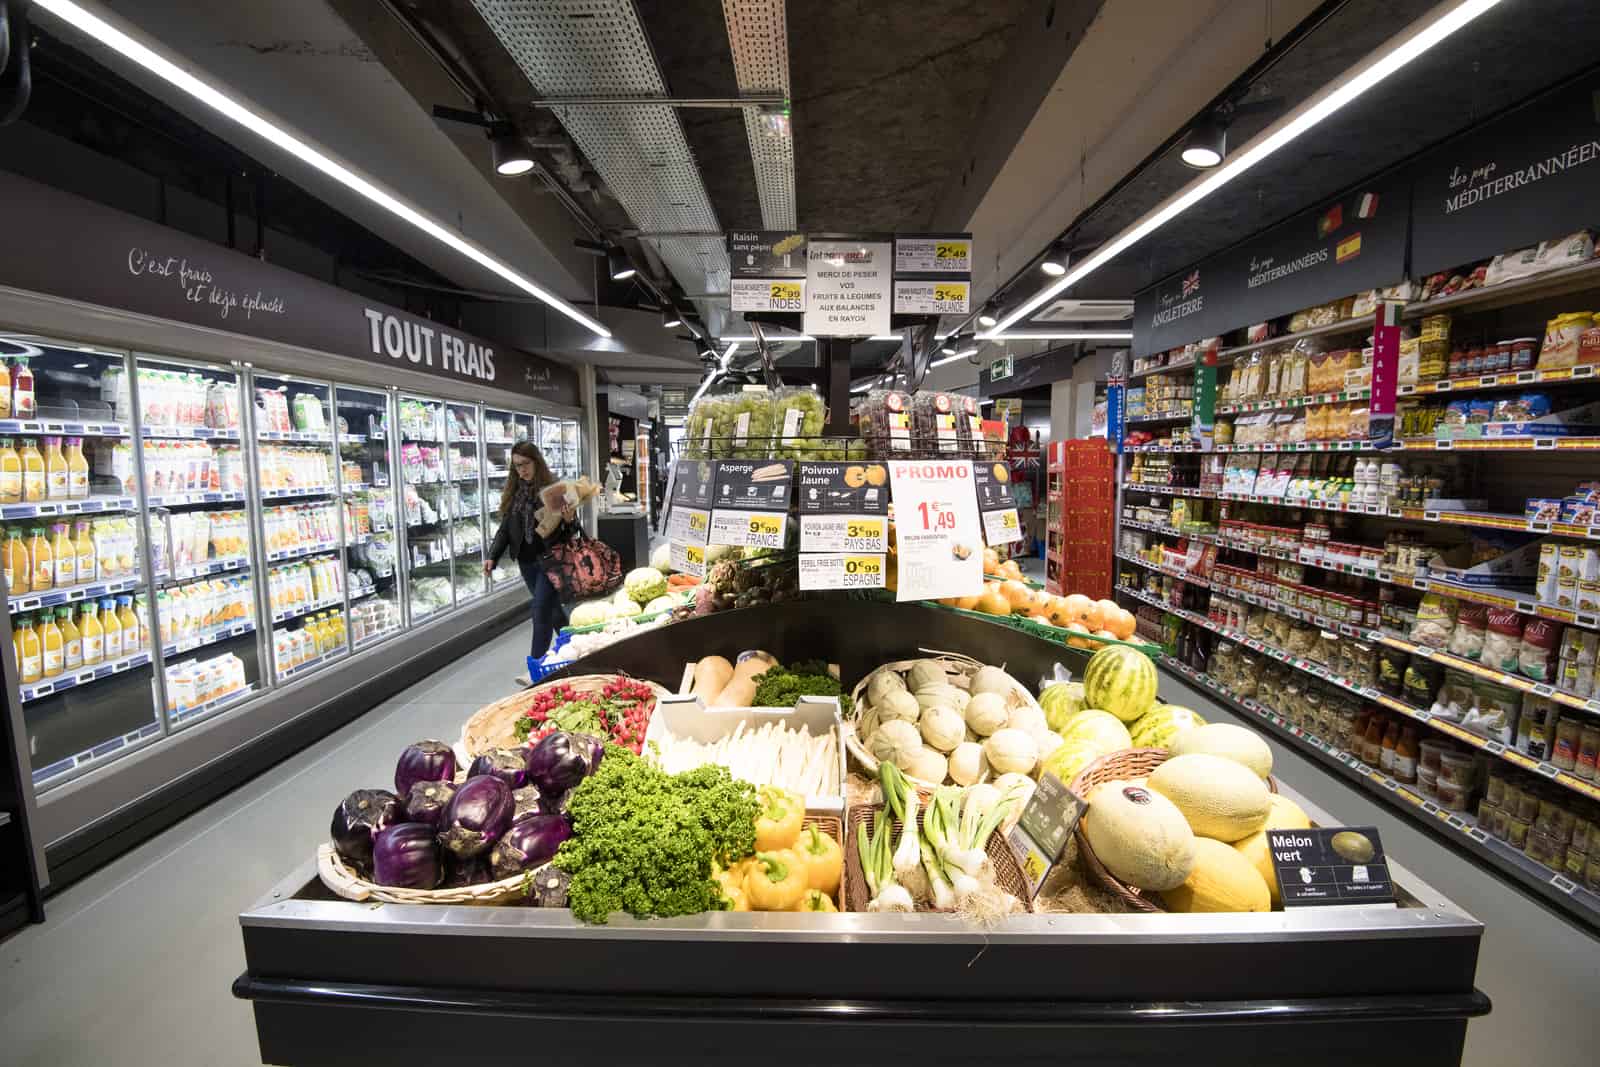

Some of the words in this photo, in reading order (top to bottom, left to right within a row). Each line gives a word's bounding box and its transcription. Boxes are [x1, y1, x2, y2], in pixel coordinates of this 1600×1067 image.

[733, 232, 759, 241] Raisin
[128, 247, 177, 276] C'est
[178, 259, 213, 289] frais
[816, 271, 840, 279] MERCI
[841, 271, 852, 279] DE
[853, 271, 878, 279] PESER
[186, 284, 207, 301] et
[812, 292, 838, 300] FRUITS
[769, 298, 802, 310] INDES
[1151, 296, 1203, 329] ANGLETERRE
[364, 307, 434, 366] TOUT
[440, 333, 496, 380] FRAIS
[1373, 330, 1385, 411] ITALIE
[720, 463, 754, 473] Asperge
[801, 465, 840, 475] Poivron
[895, 465, 969, 479] PROMO
[801, 475, 831, 485] Jaune
[745, 533, 779, 547] FRANCE
[844, 538, 865, 550] PAYS
[866, 538, 881, 550] BAS
[843, 574, 881, 586] ESPAGNE
[1272, 834, 1313, 847] Melon
[1275, 850, 1302, 862] vert
